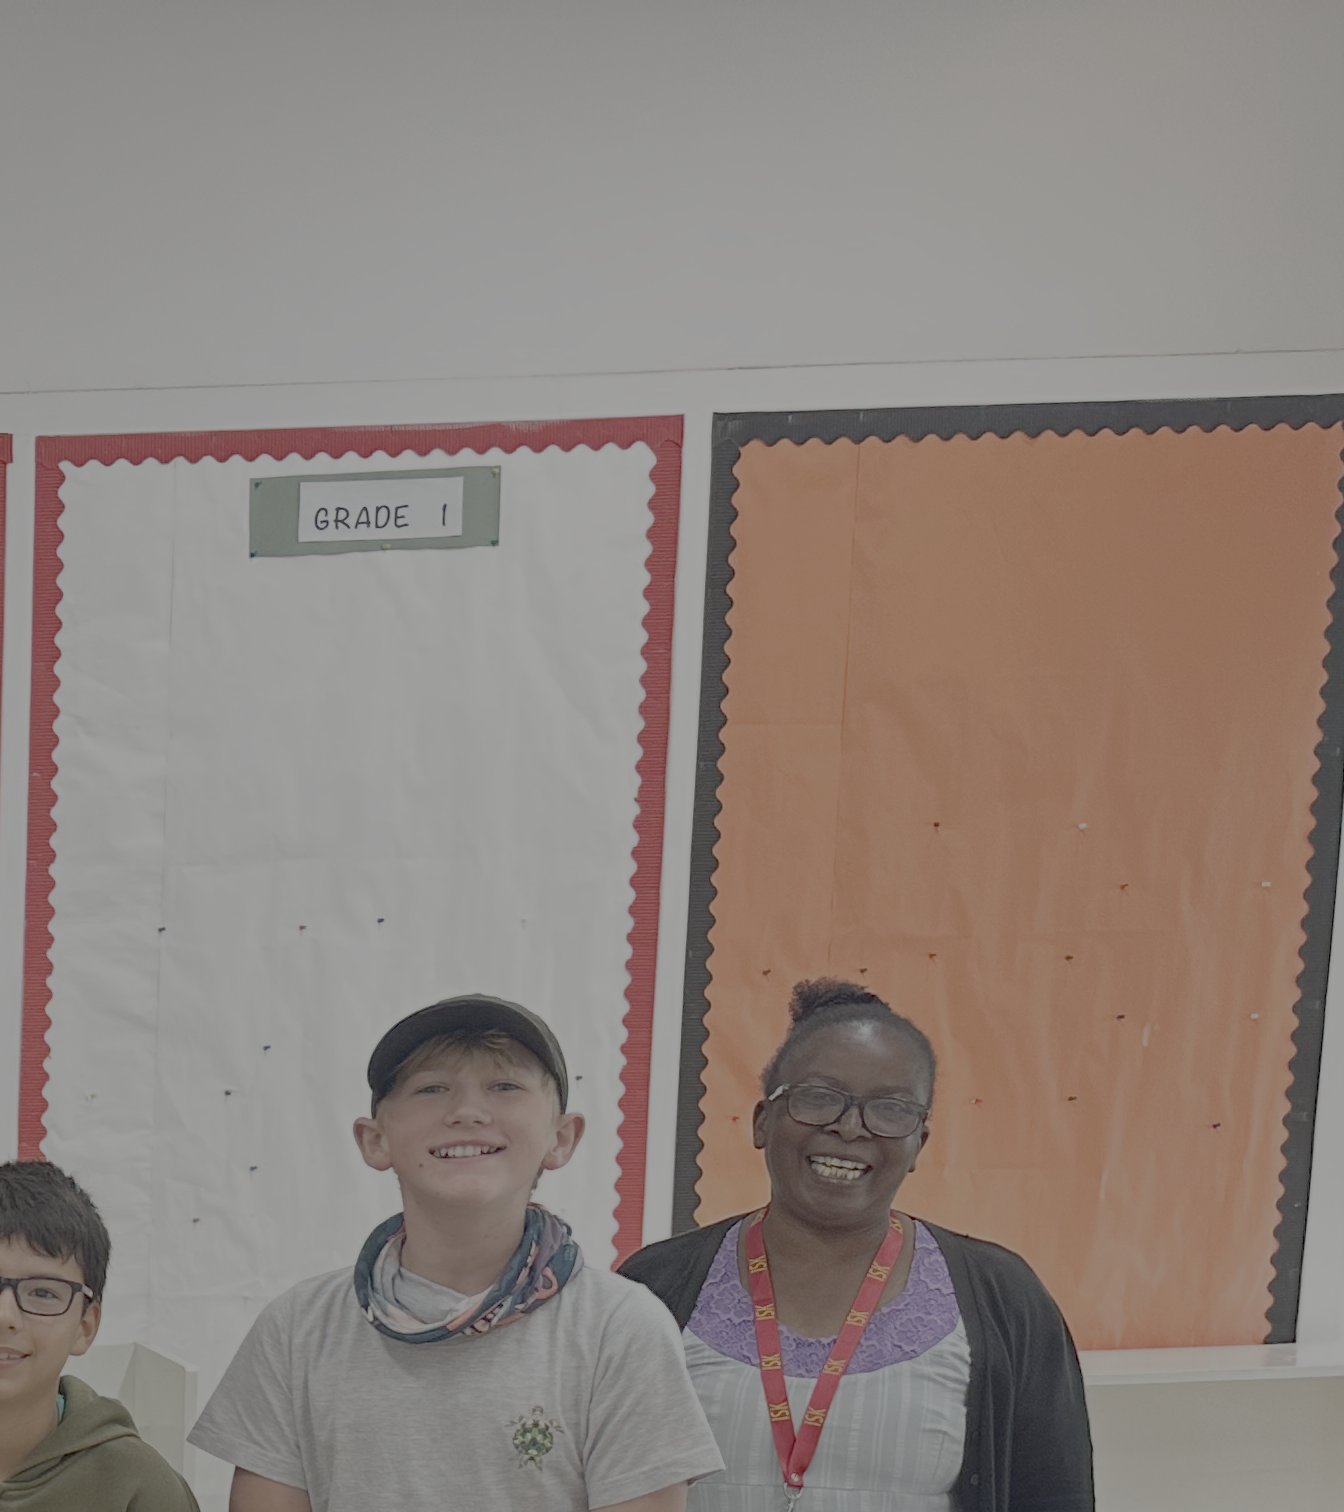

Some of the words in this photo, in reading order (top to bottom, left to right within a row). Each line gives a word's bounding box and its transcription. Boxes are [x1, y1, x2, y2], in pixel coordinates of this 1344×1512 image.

[314, 504, 410, 531] GRADE
[441, 503, 448, 527] 1
[748, 1254, 768, 1275] ISK
[866, 1260, 890, 1282] ISK
[755, 1303, 776, 1321] ISK
[845, 1308, 870, 1327] ISK
[761, 1353, 782, 1371] ISK
[823, 1357, 847, 1376] ISK
[769, 1401, 791, 1422] ISK
[804, 1406, 828, 1427] ISK
